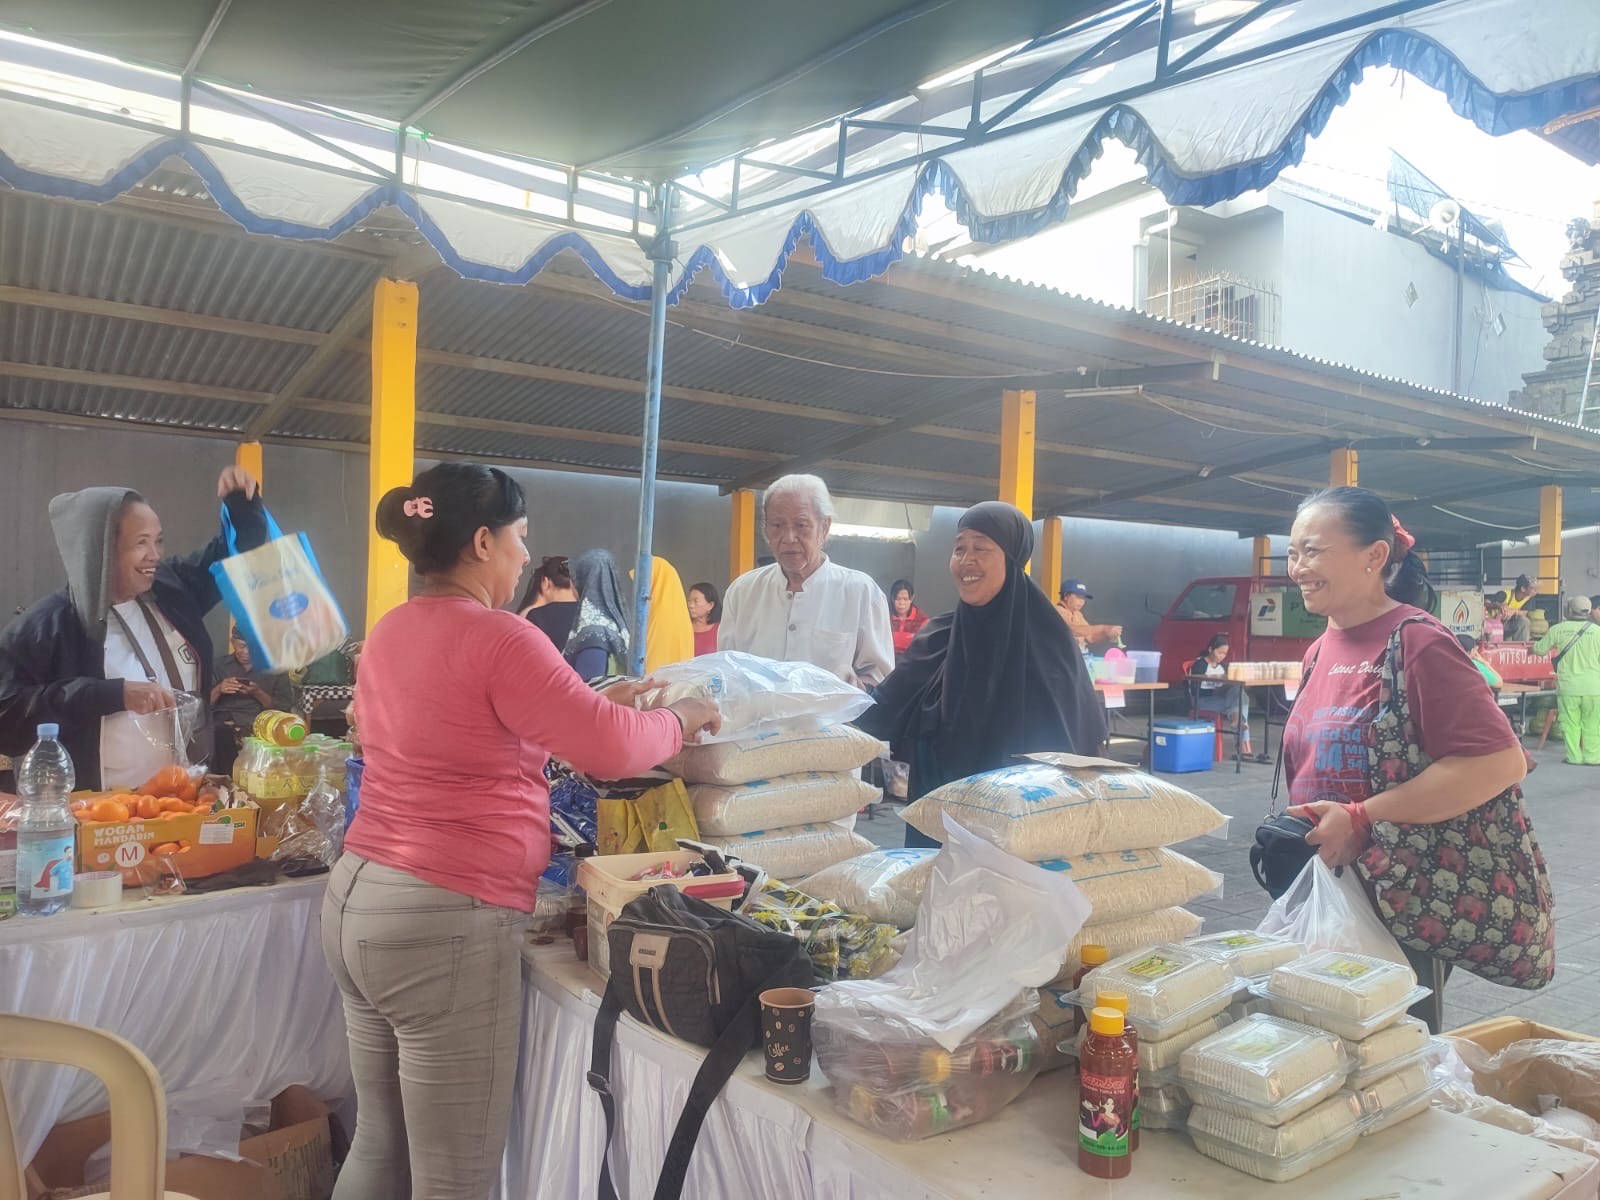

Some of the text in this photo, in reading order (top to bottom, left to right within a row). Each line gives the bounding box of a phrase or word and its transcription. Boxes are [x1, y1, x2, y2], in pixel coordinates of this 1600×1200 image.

[1499, 650, 1552, 665] MITSUBISHI
[1357, 660, 1384, 679] Desig
[94, 831, 155, 847] MANDARIN
[121, 845, 138, 862] M
[767, 1042, 791, 1058] Coffee
